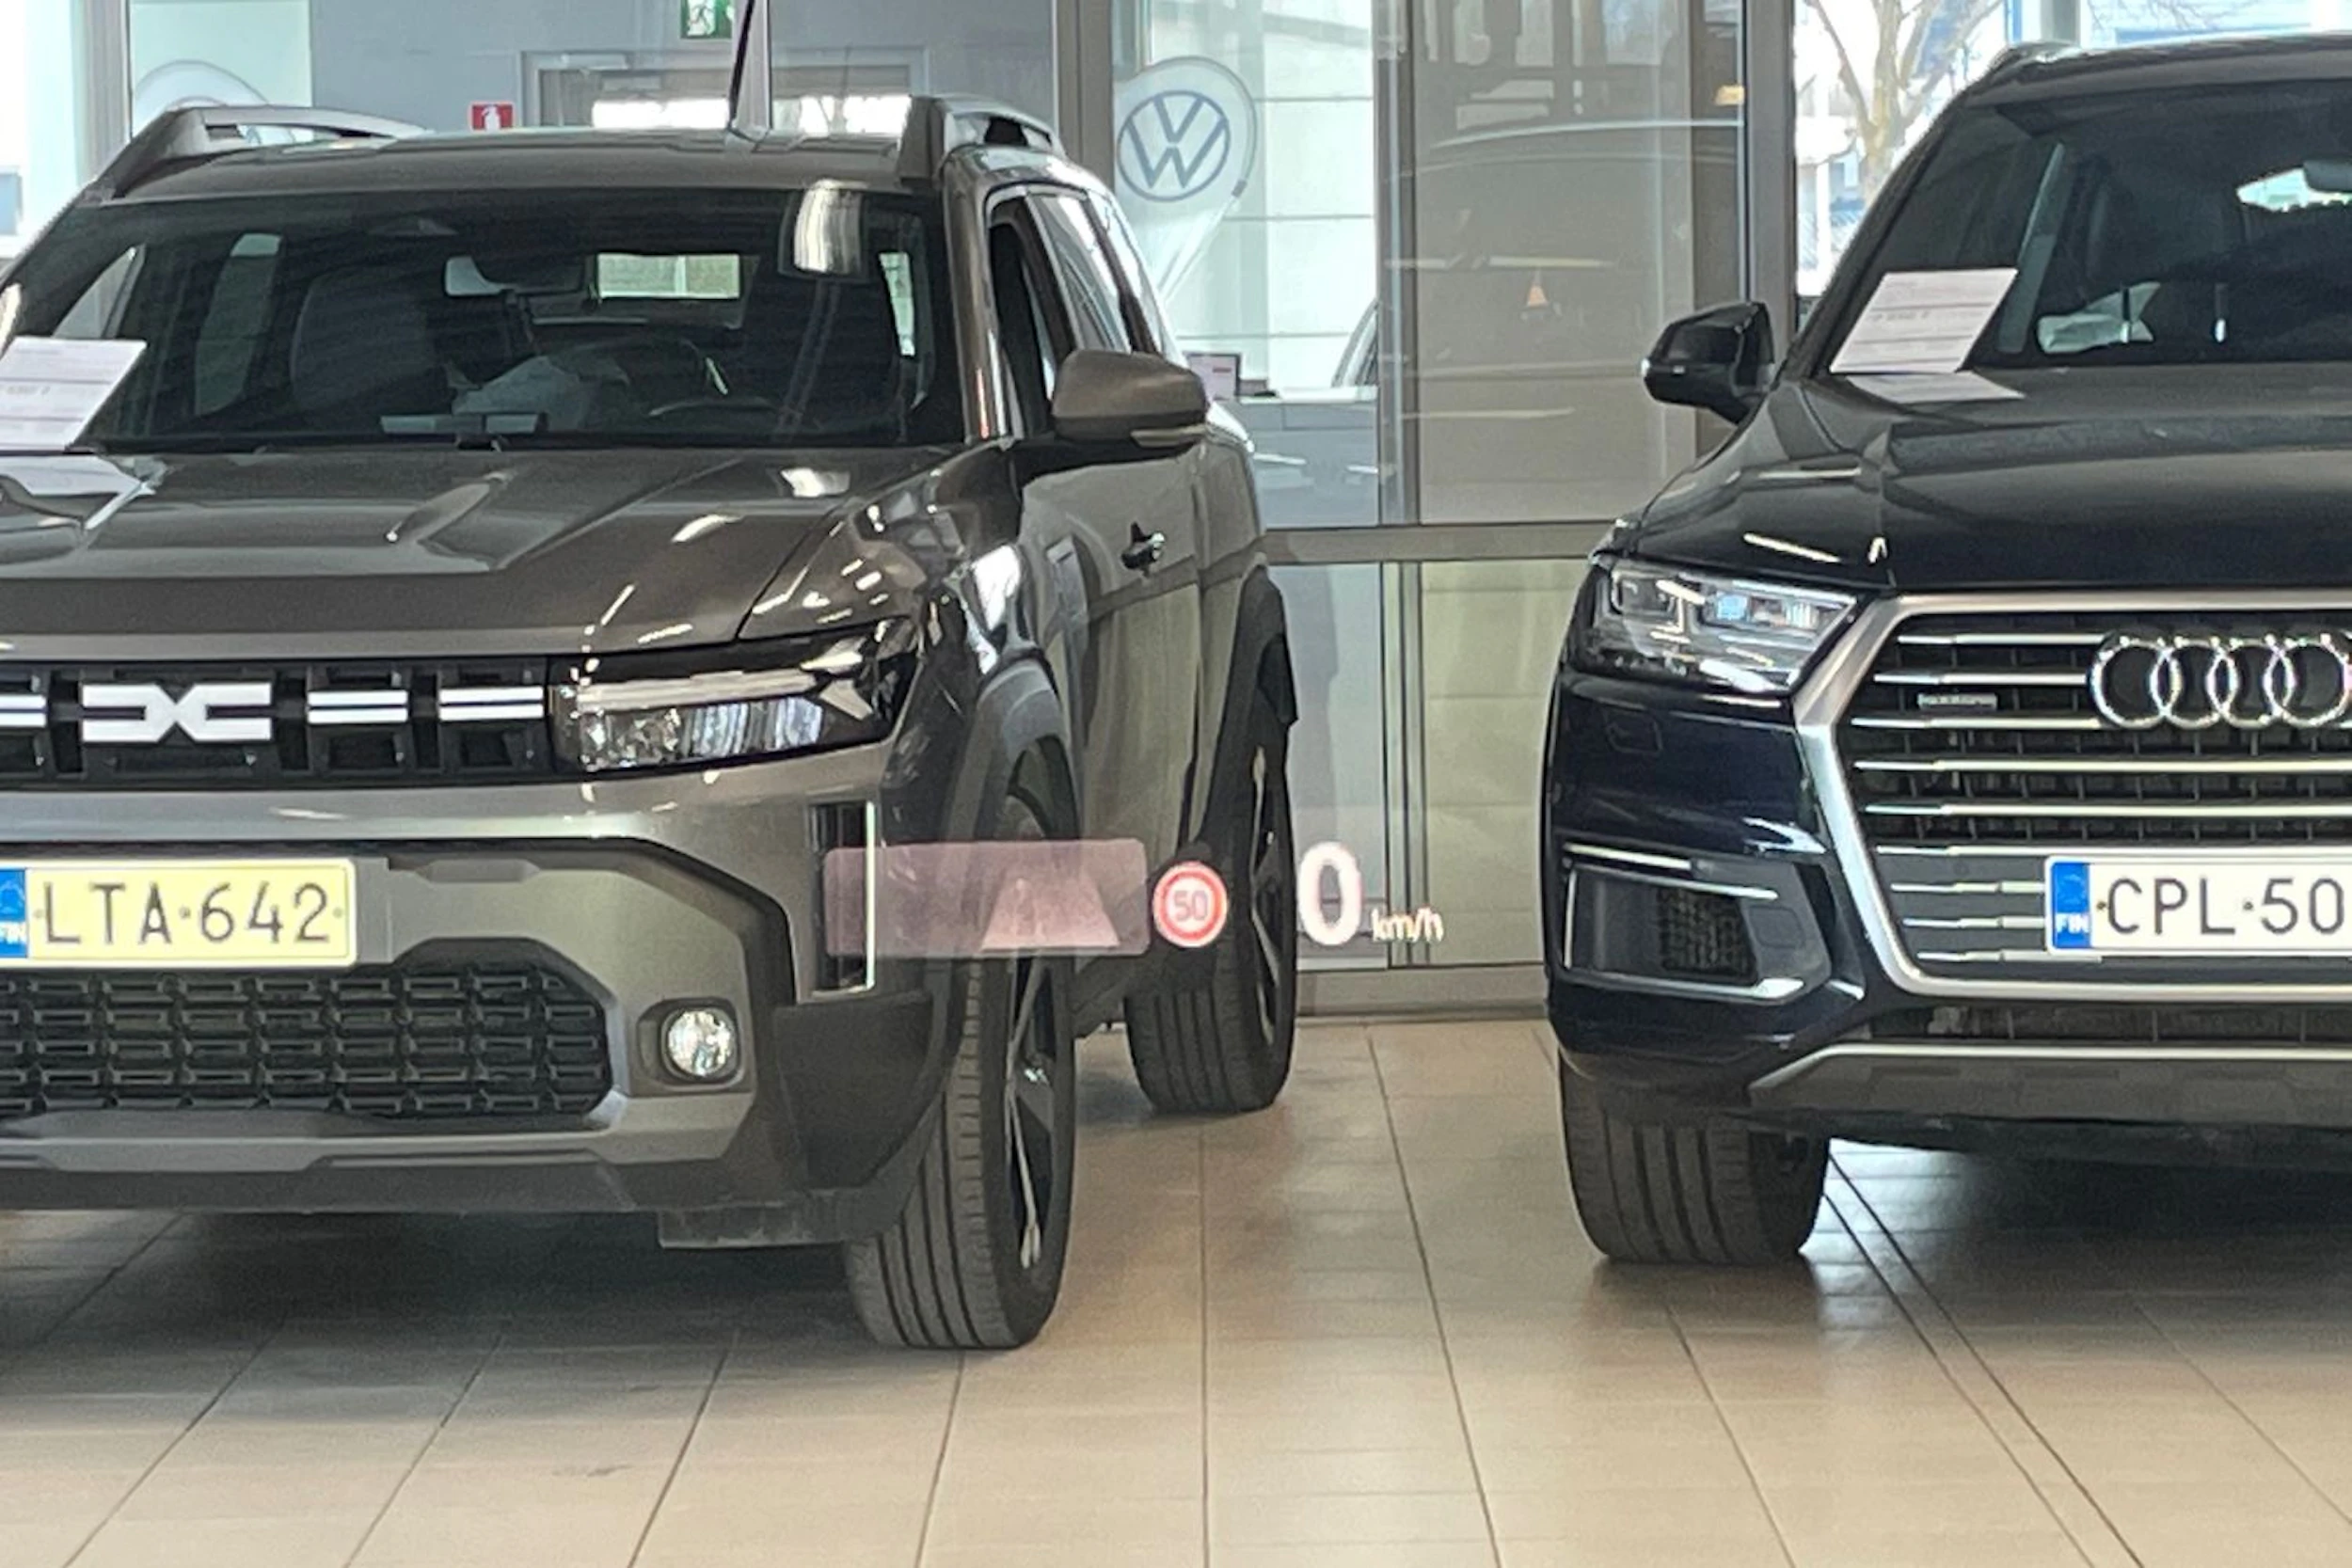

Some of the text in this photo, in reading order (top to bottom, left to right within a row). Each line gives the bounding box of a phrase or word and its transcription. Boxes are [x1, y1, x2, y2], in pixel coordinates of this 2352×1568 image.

[1117, 90, 1231, 202] VW
[1173, 890, 1209, 922] 50
[1297, 841, 1443, 945] 0 km/h
[2055, 912, 2090, 934] FIN
